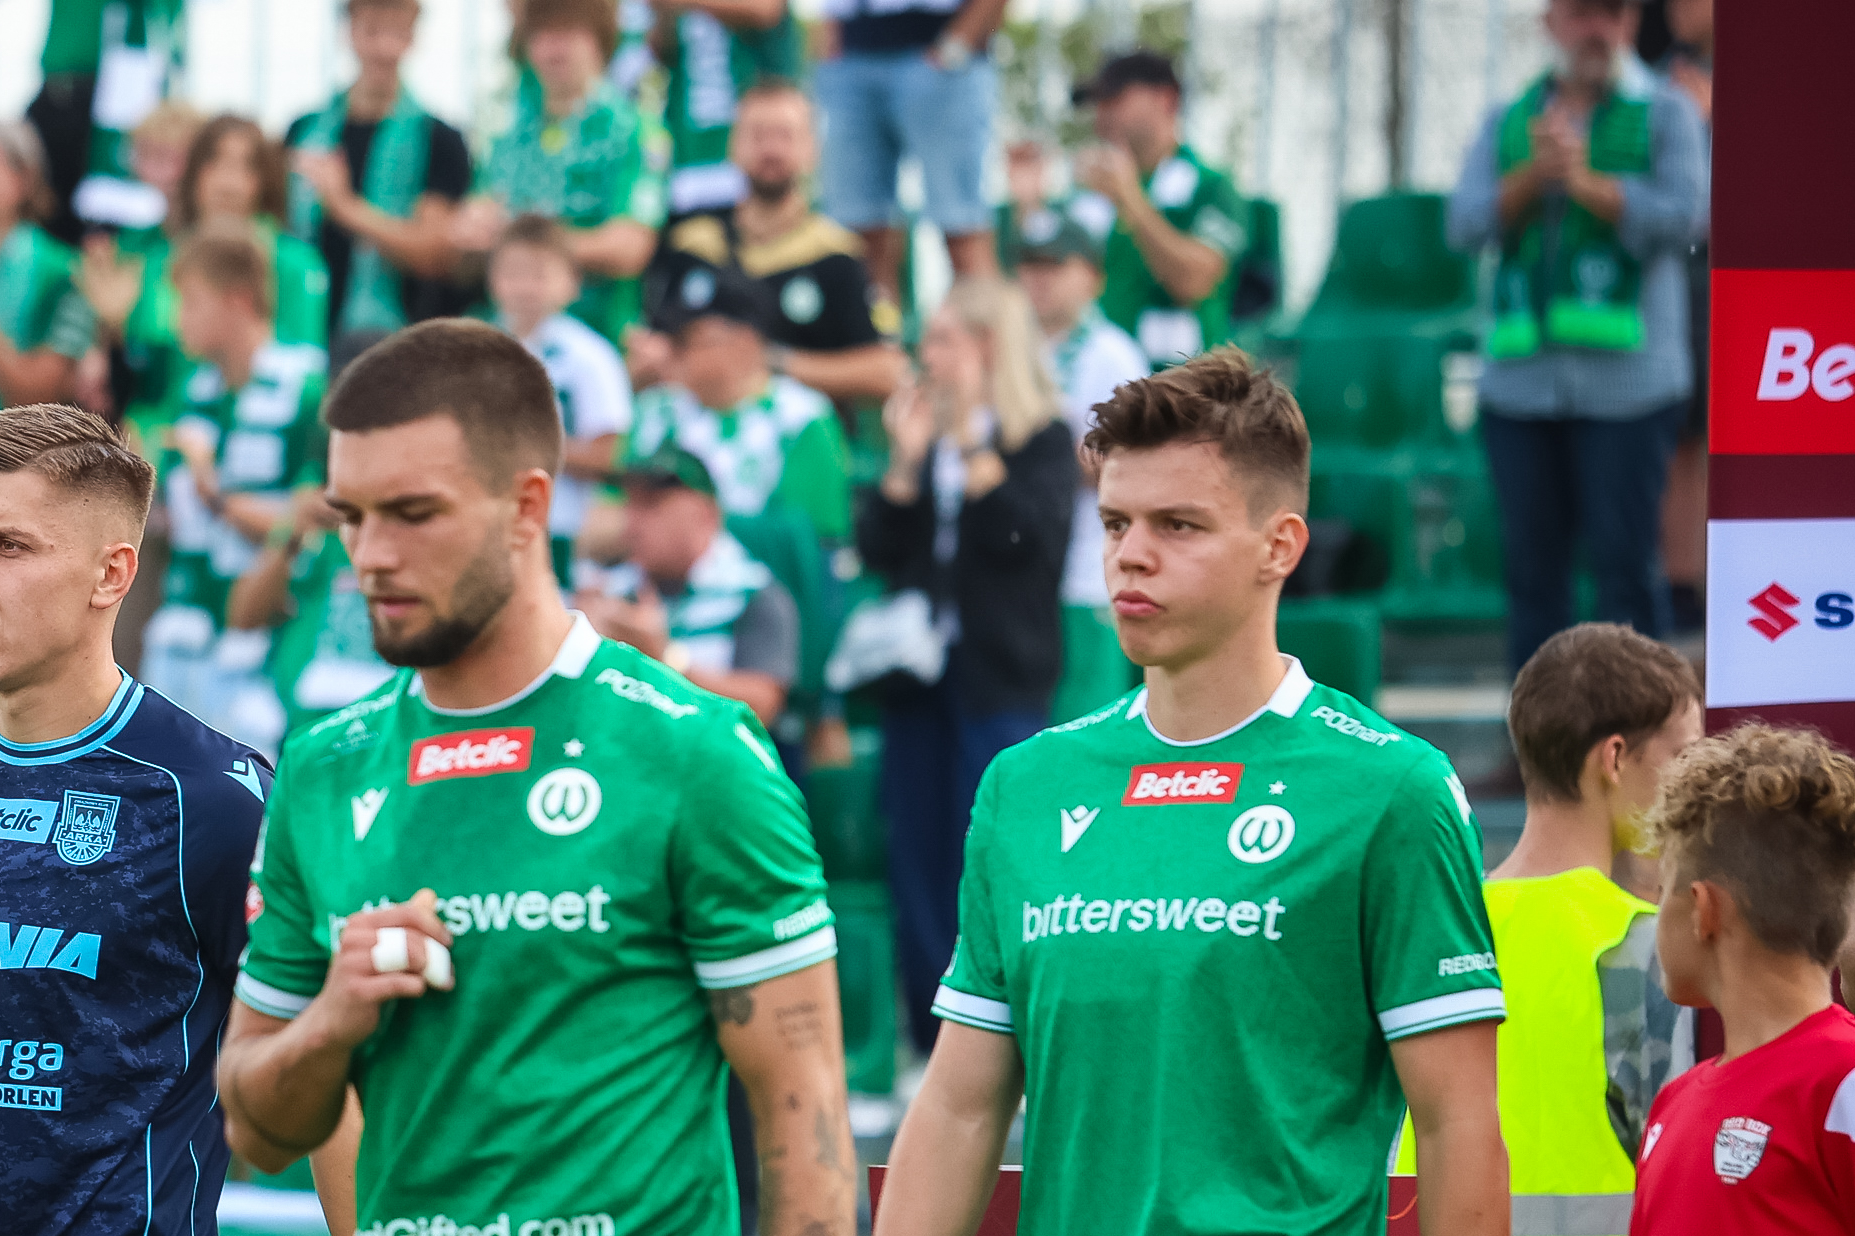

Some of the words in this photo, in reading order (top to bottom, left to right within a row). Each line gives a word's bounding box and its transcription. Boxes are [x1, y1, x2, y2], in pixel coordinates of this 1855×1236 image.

[1757, 327, 1855, 402] Be
[1814, 590, 1854, 631] S
[416, 734, 523, 777] Betclic
[1131, 768, 1232, 799] Betclic
[65, 831, 103, 845] ARKA
[1022, 893, 1286, 943] bittersweet
